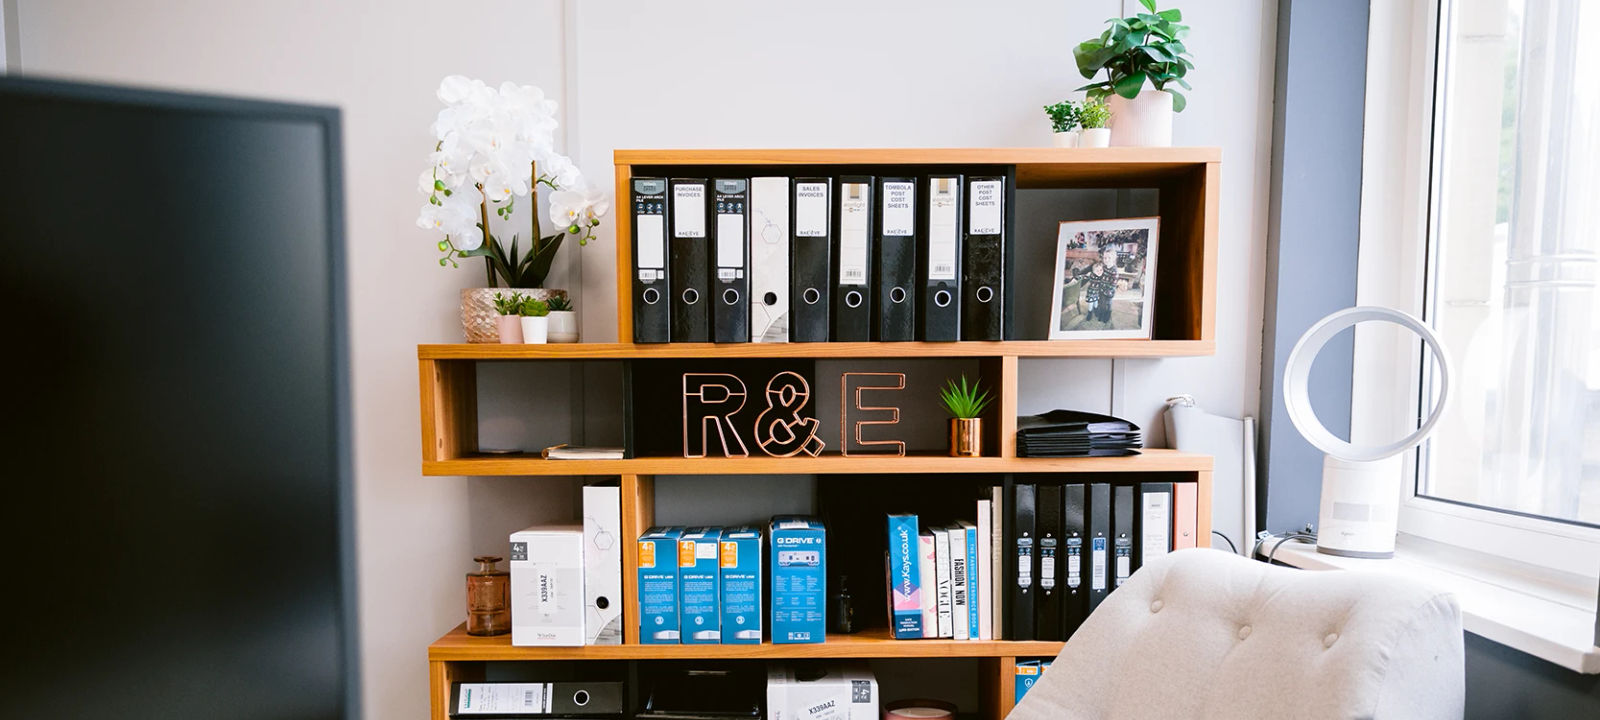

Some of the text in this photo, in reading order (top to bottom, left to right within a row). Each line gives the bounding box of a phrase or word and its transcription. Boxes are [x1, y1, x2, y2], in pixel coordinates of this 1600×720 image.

[939, 580, 950, 618] VOGUE
[954, 558, 966, 606] FASHION NOW
[808, 700, 836, 715] X339AAZ
